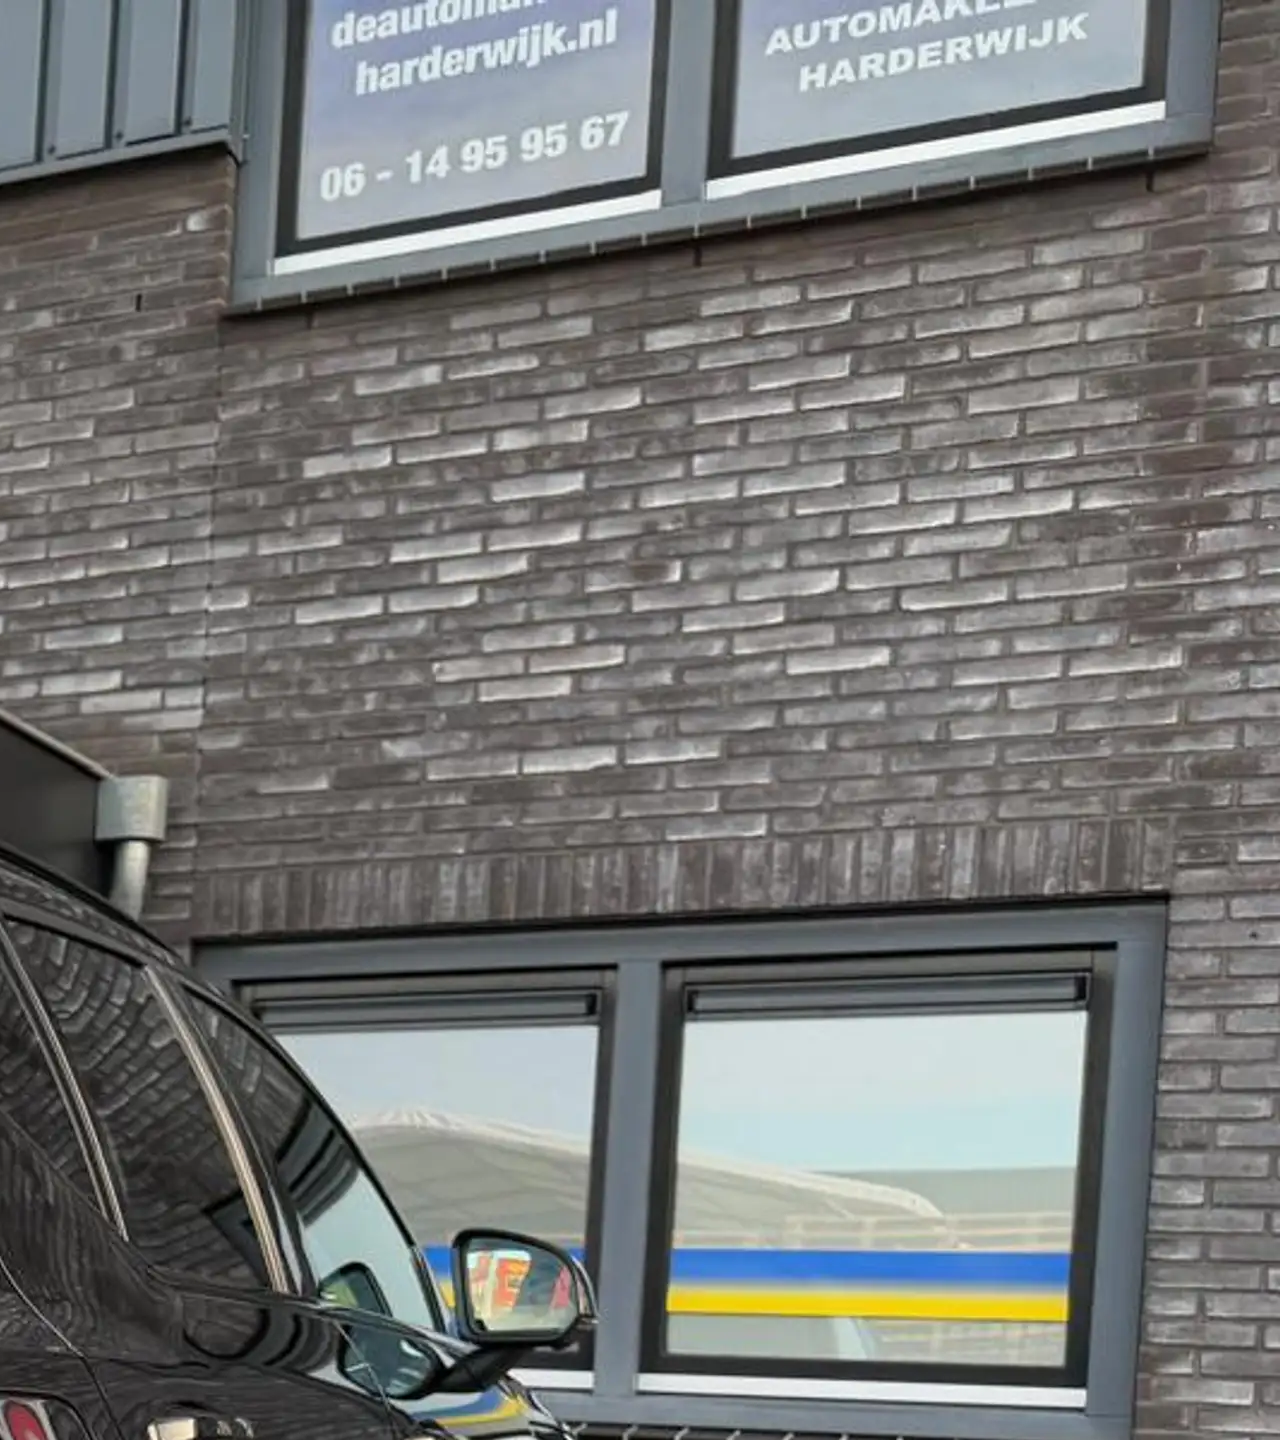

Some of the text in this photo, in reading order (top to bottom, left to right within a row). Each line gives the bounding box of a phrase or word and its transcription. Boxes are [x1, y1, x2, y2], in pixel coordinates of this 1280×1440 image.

[355, 9, 618, 97] harderwijk.nl
[798, 12, 1090, 93] HARDERWIJK
[319, 163, 366, 201] 06
[405, 145, 451, 184] 14
[460, 134, 508, 173] 95
[520, 124, 568, 163] 95
[579, 110, 630, 152] 67
